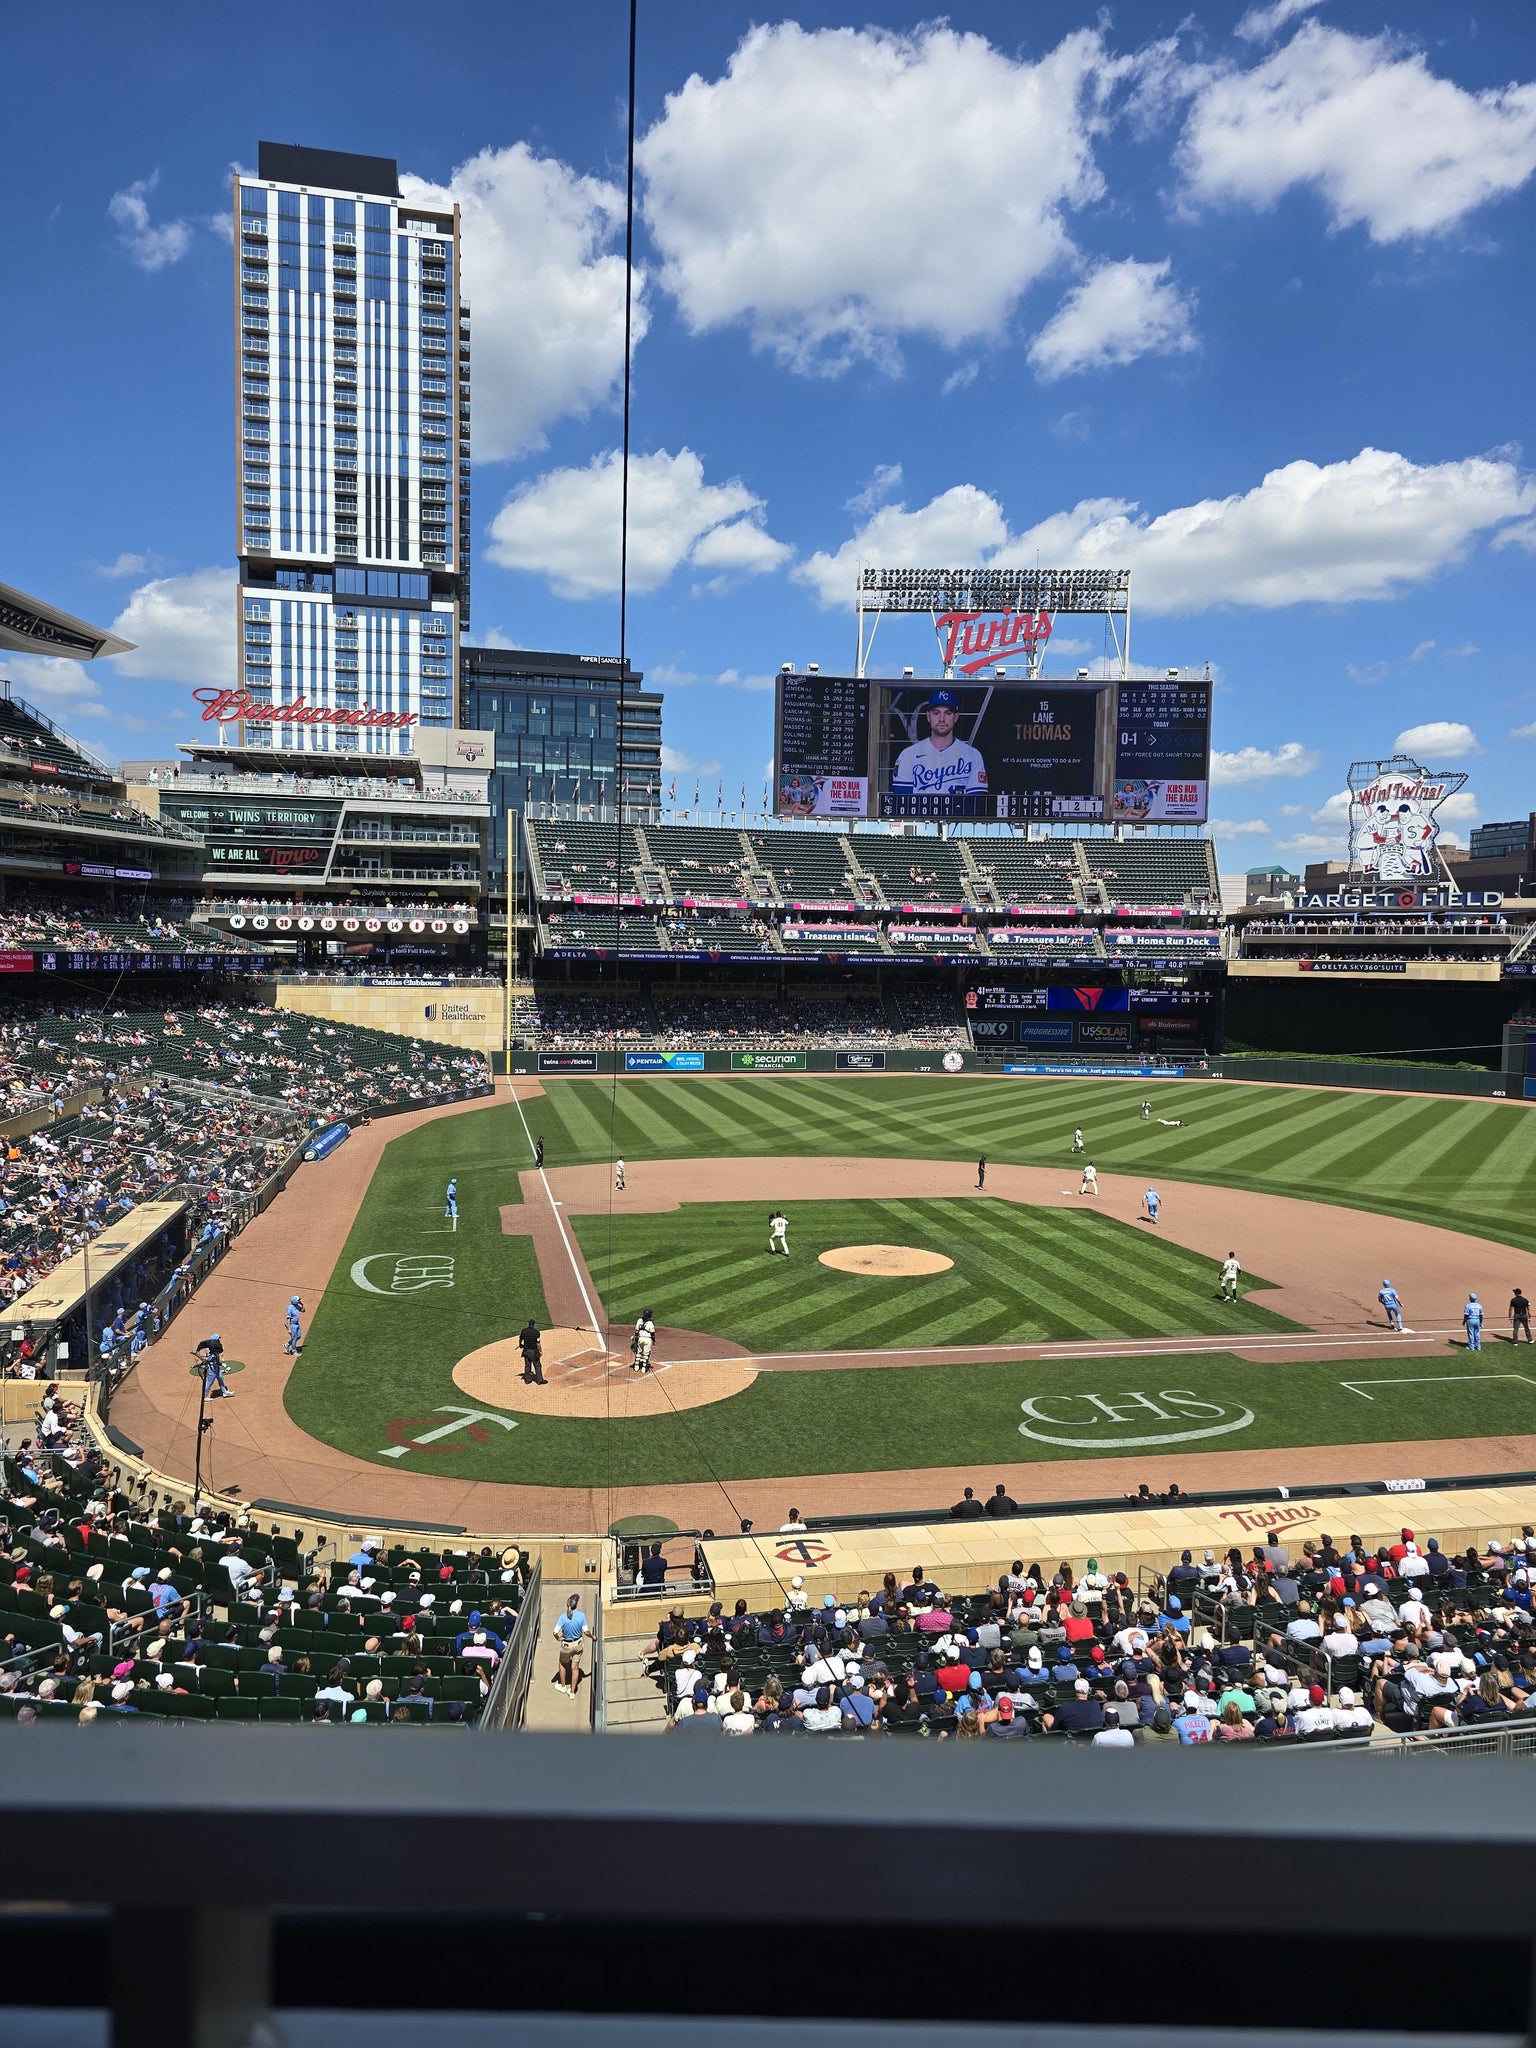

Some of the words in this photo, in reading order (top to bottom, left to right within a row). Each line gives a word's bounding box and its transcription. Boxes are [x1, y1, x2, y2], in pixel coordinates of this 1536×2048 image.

[936, 604, 1053, 667] Twins
[192, 688, 418, 729] Budweiser
[1040, 701, 1049, 711] 15
[1032, 712, 1054, 723] LANE
[1015, 724, 1072, 741] THOMAS
[912, 757, 973, 791] Royals
[1359, 781, 1392, 804] Win!
[1393, 780, 1444, 801] Twins!
[181, 810, 209, 820] WELCOME
[229, 810, 260, 823] TWINS
[267, 811, 316, 823] TERRITORY
[1367, 823, 1376, 832] M
[1407, 825, 1418, 839] S
[213, 848, 225, 860] WE
[228, 848, 243, 860] ARE
[246, 849, 260, 861] ALL
[264, 848, 319, 869] Twins
[582, 896, 613, 904] Treasure
[1296, 892, 1394, 908] TARGET
[1422, 891, 1503, 907] FIELD
[800, 903, 828, 911] Treasure
[830, 903, 849, 911] Island
[1018, 907, 1046, 915] Treasure
[234, 918, 242, 926] W
[256, 919, 265, 927] 42
[369, 921, 377, 929] 34
[391, 922, 398, 930] 14
[803, 932, 841, 940] Treasure
[908, 933, 933, 941] Home
[934, 934, 951, 942] Run
[953, 934, 973, 942] Deck
[1014, 936, 1049, 944] Treasure
[1137, 937, 1164, 945] Home
[1166, 937, 1186, 946] Run
[1188, 937, 1210, 946] Deck
[441, 1004, 469, 1012] United
[441, 1012, 486, 1021] Healthcare
[998, 1022, 1007, 1034] 9
[1023, 1028, 1070, 1036] PROGRESSIVE
[543, 1058, 593, 1066] twins.com/tickets
[754, 1054, 797, 1063] securian
[1019, 1390, 1240, 1432] CHS
[1219, 1505, 1322, 1533] Twins
